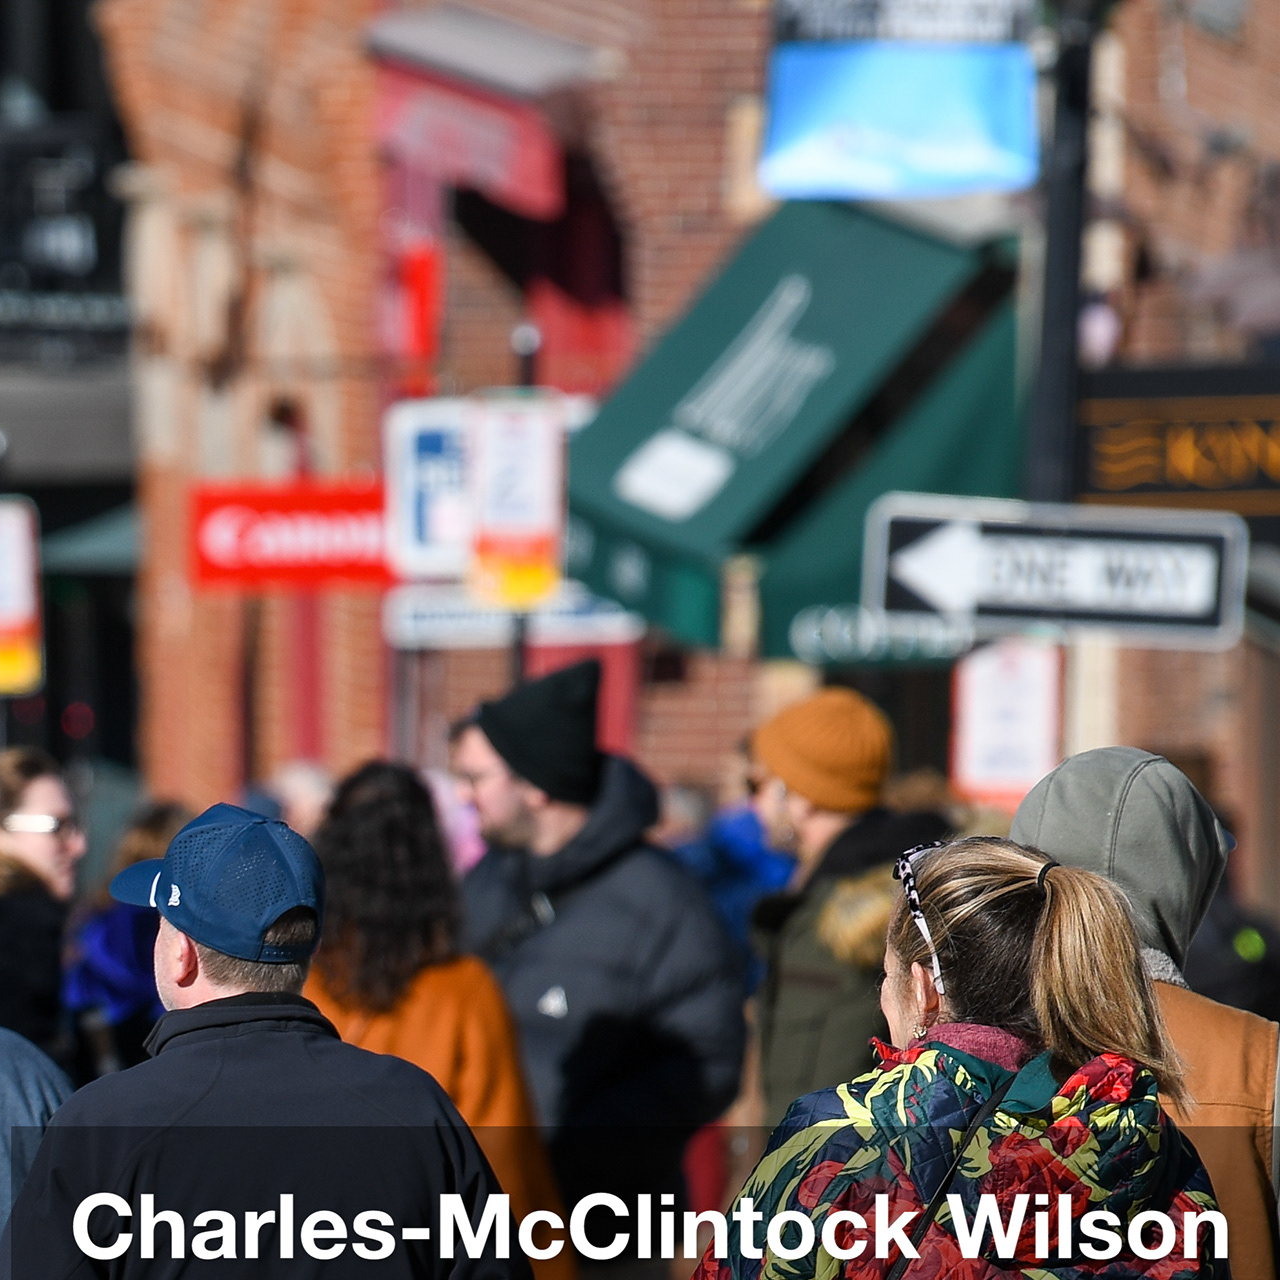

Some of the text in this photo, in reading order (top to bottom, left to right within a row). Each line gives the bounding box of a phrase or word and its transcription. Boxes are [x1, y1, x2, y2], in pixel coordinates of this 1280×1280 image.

[197, 505, 387, 568] Canon
[986, 540, 1202, 600] ONE WAY
